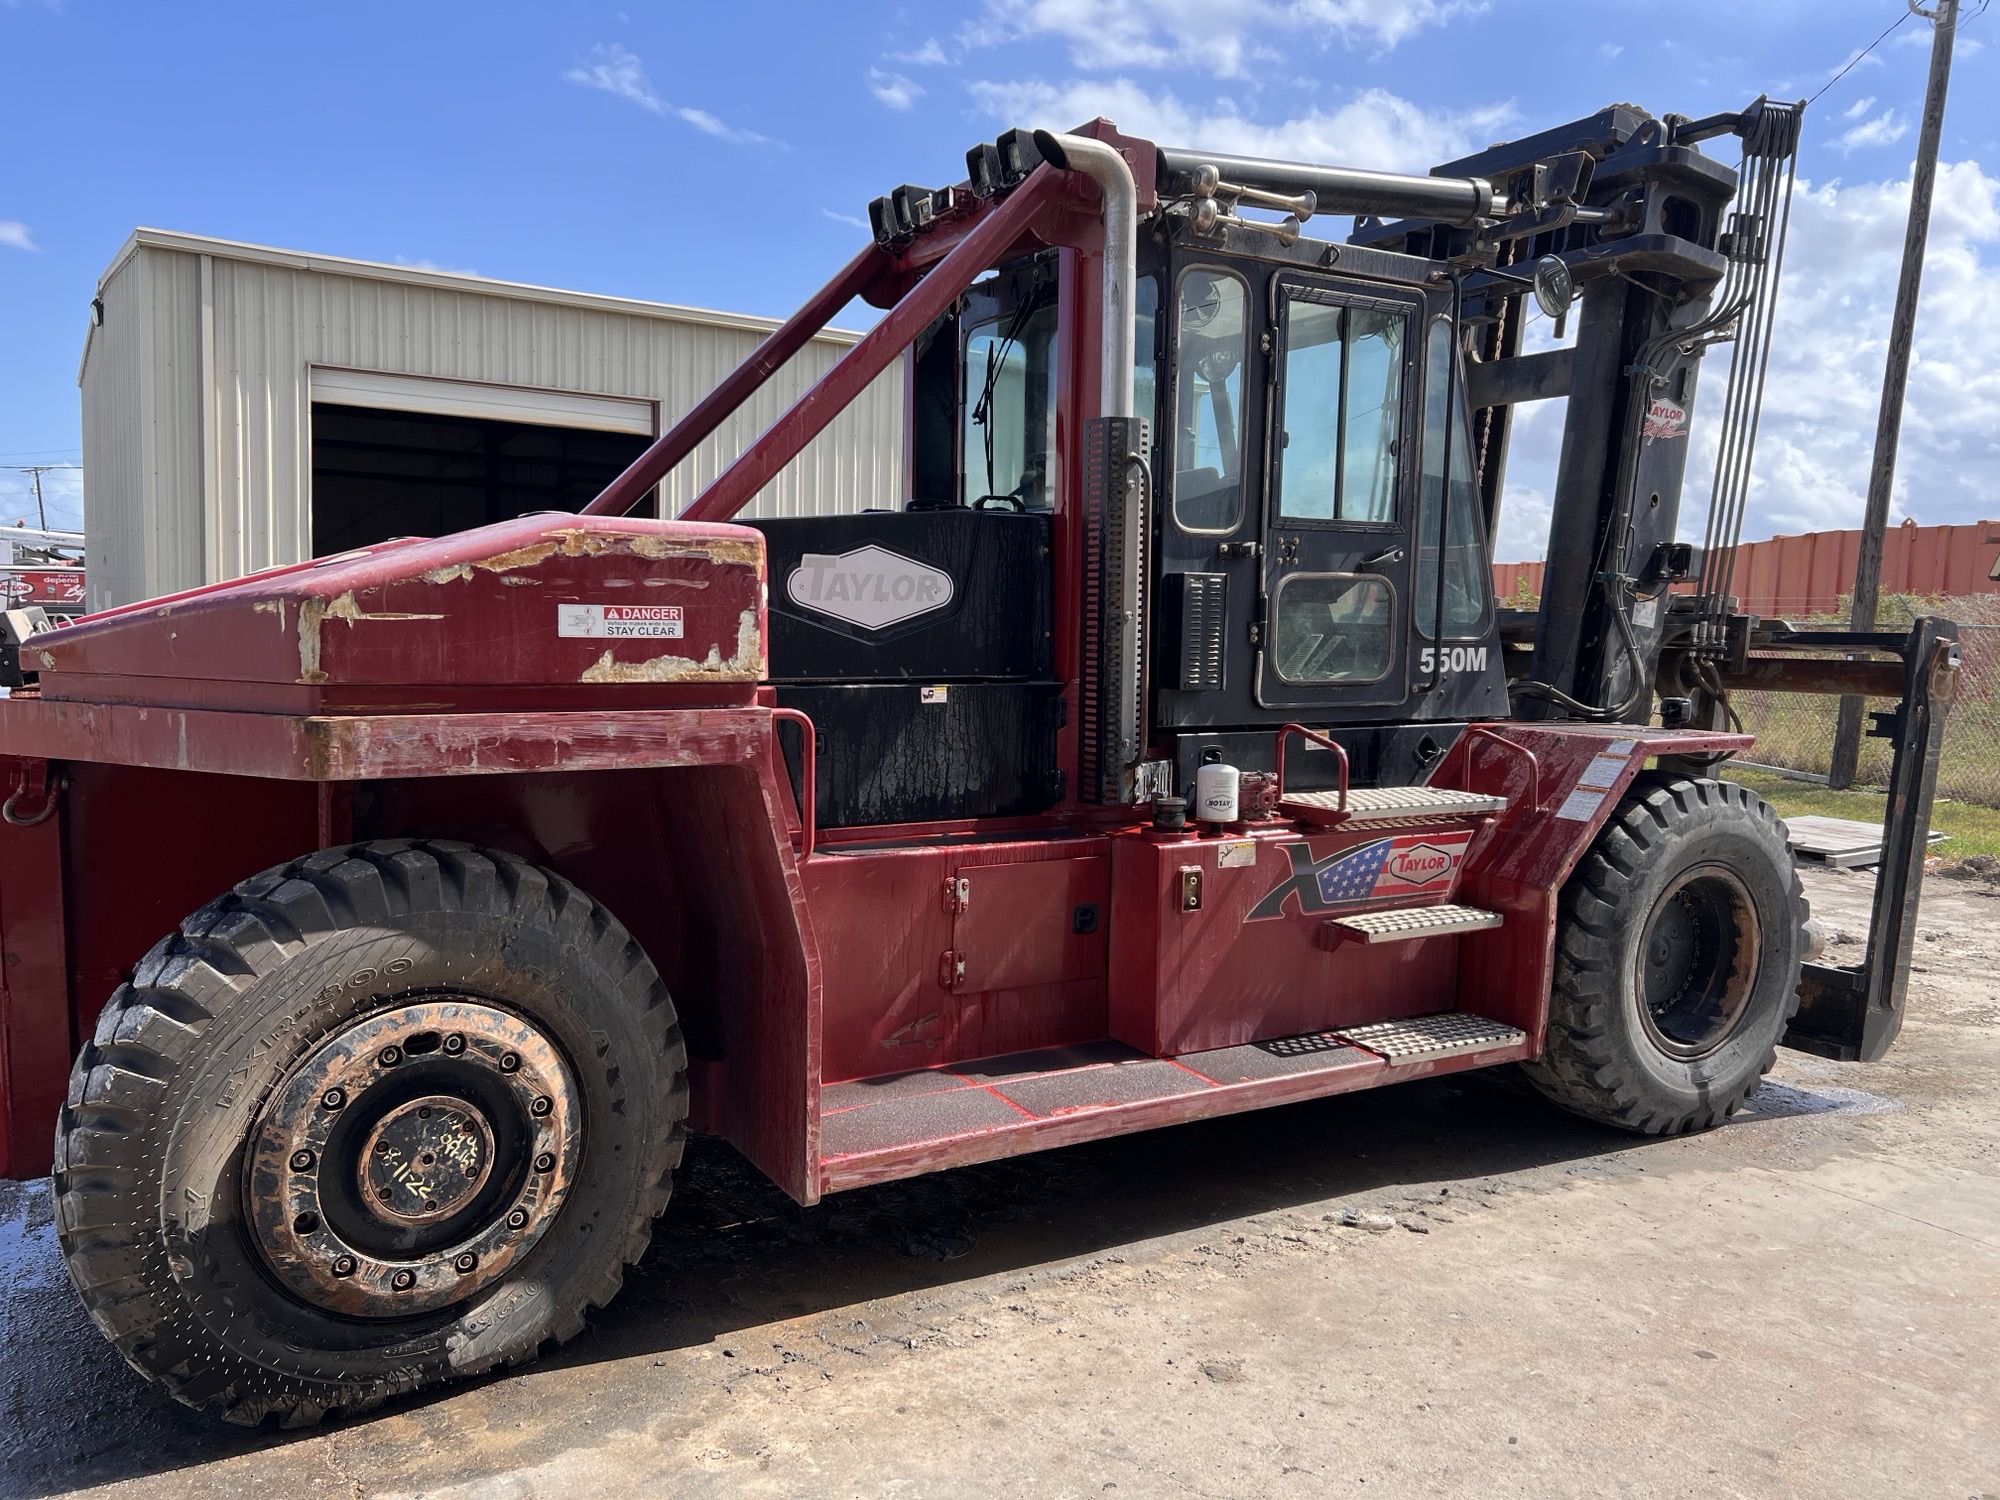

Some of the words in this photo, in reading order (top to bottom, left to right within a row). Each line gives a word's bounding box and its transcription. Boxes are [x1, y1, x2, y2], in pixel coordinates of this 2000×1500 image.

[803, 556, 938, 602] TAYLOR
[622, 608, 679, 620] DANGER
[607, 626, 635, 635] STAY
[638, 627, 675, 636] CLEAR
[1420, 647, 1487, 673] 550M
[1208, 800, 1233, 809] TAYLOR
[1397, 853, 1445, 873] TAYLOR
